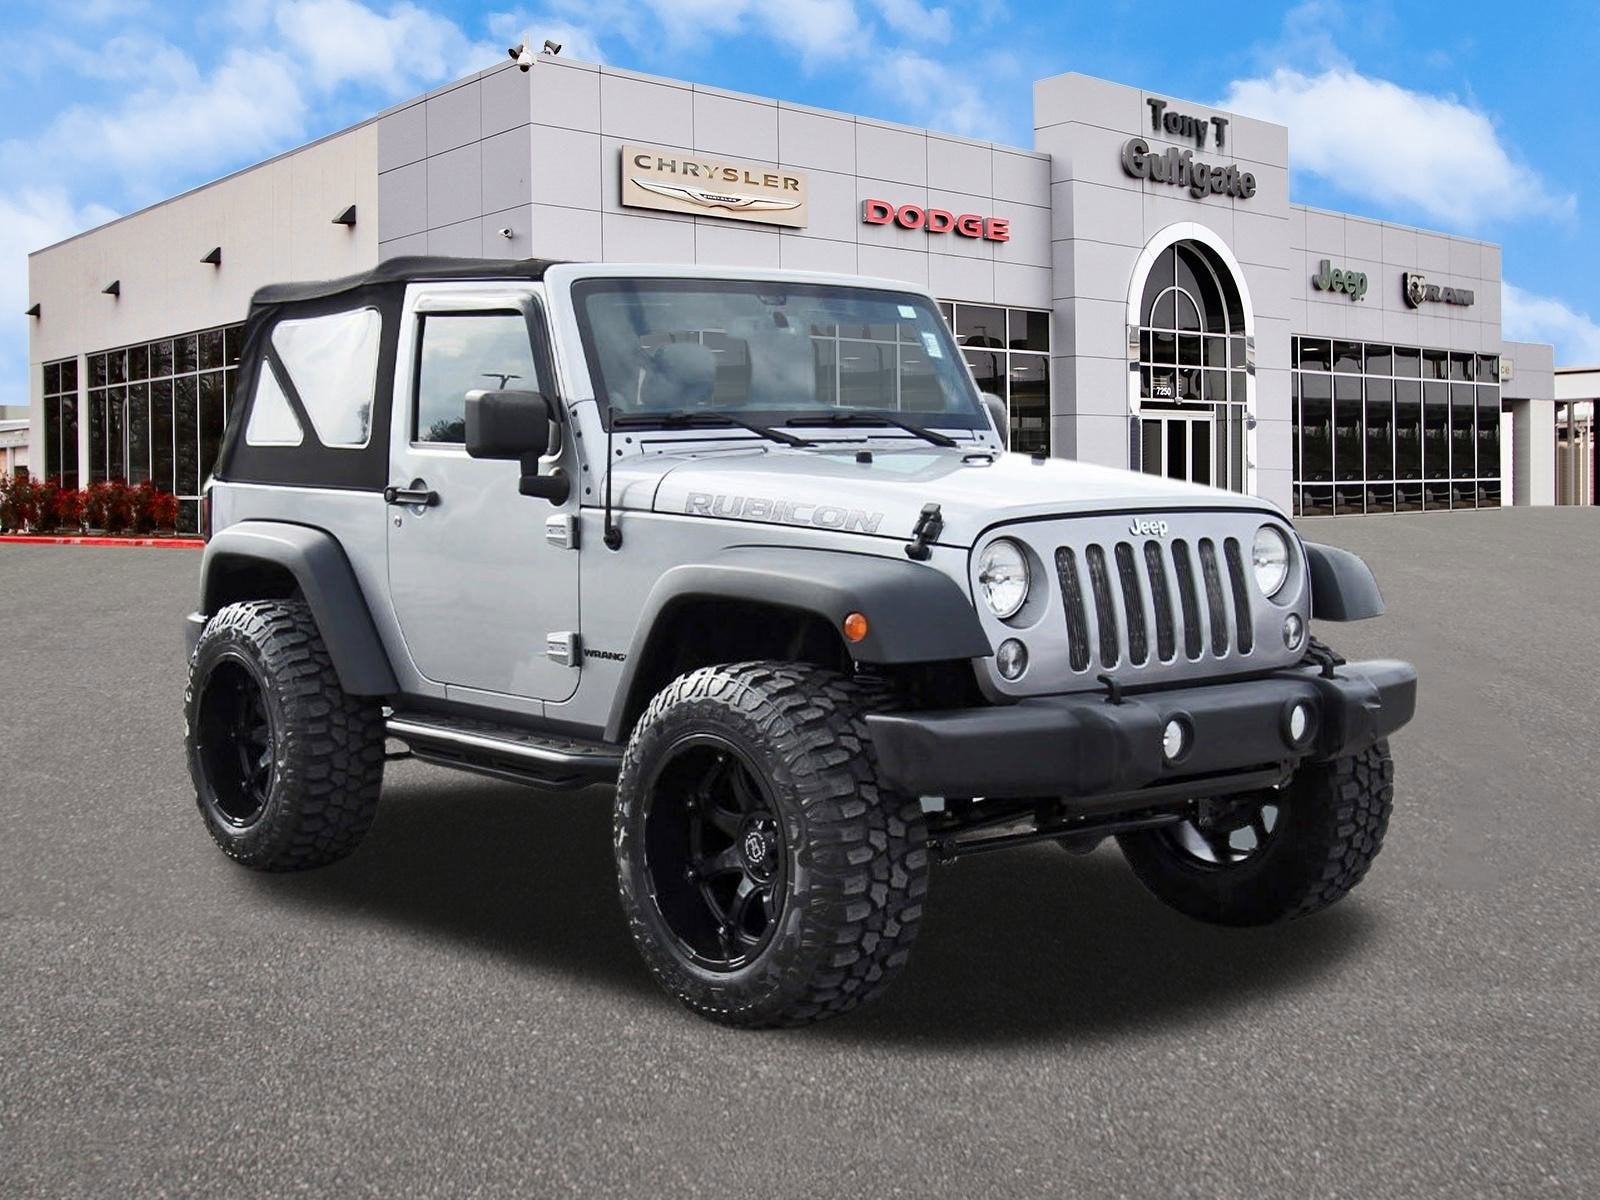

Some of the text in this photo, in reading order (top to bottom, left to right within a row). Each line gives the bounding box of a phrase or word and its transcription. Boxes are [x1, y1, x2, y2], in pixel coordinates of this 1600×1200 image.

[1146, 98, 1229, 147] Tony T
[633, 153, 800, 192] CHRYSLER
[1121, 138, 1256, 199] Gulfgate
[861, 198, 1011, 243] DODGE
[1312, 259, 1368, 301] Jeep
[1424, 284, 1475, 307] RAM
[684, 491, 884, 533] RUBICON
[1128, 517, 1168, 538] Jeep
